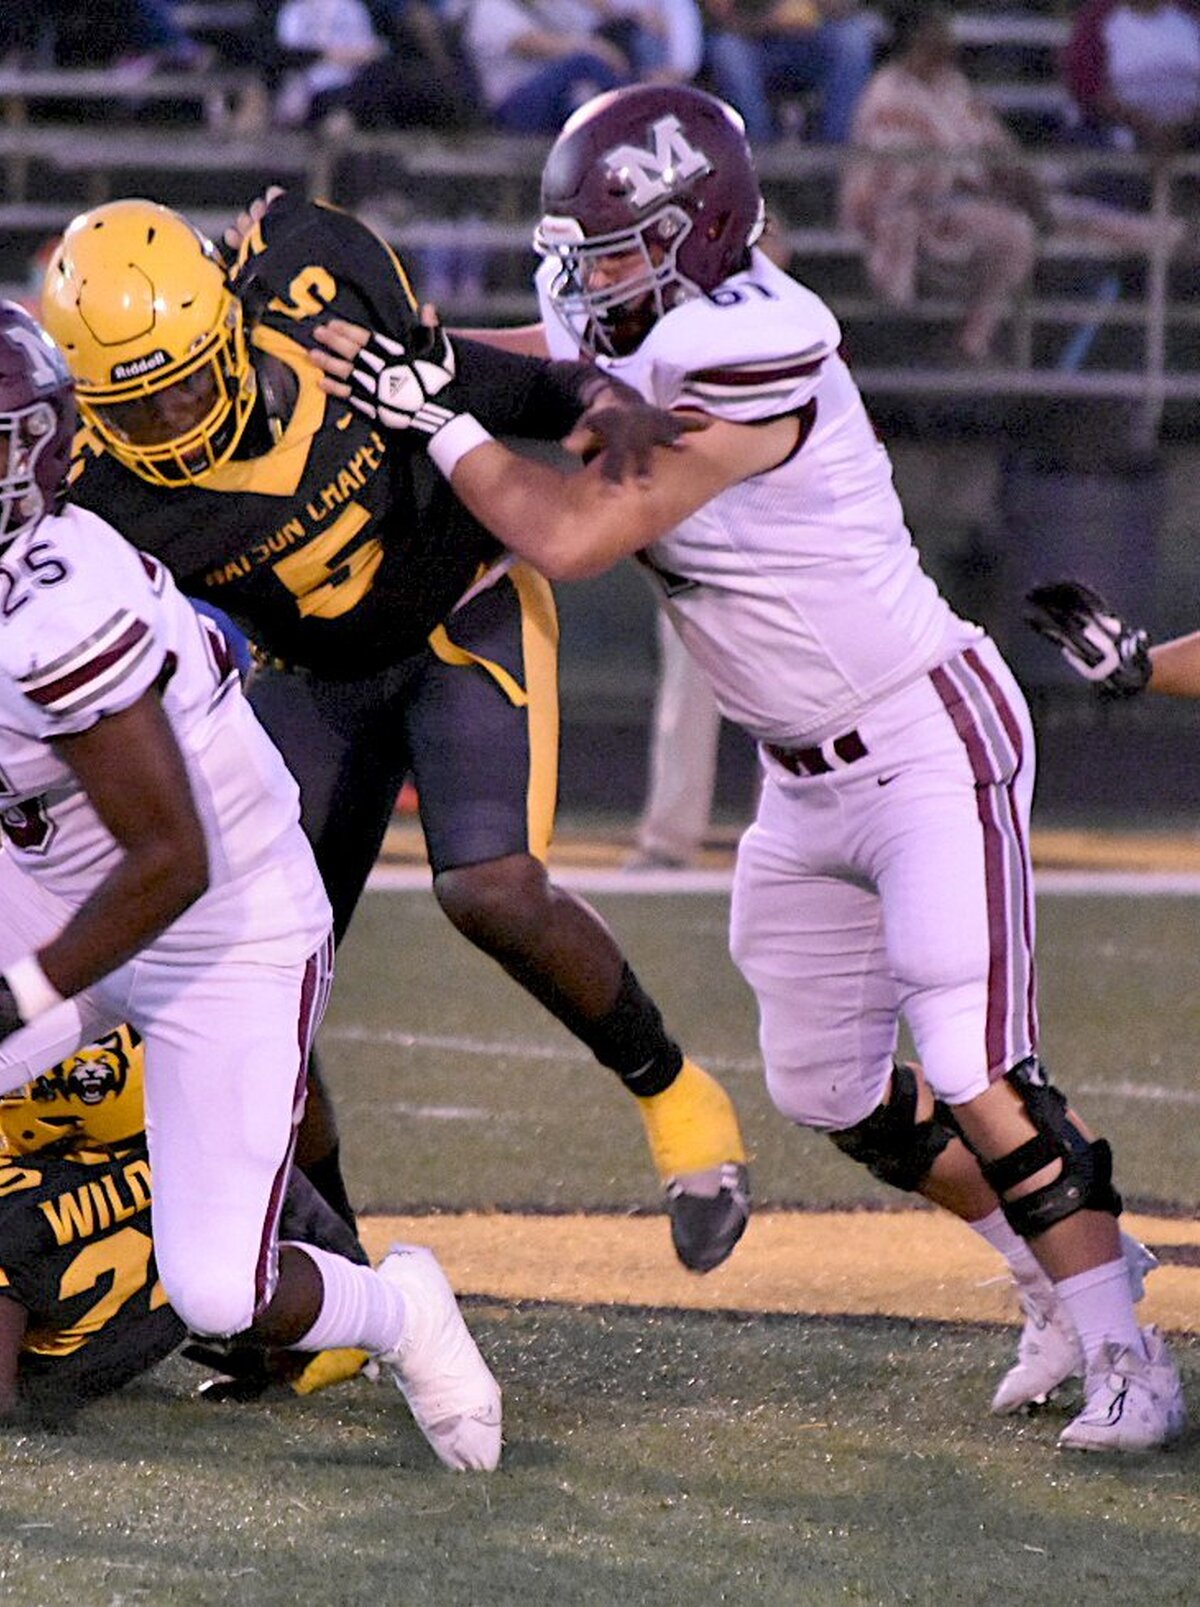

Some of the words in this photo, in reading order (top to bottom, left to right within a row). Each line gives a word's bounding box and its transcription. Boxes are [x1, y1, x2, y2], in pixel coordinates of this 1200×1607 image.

[602, 113, 713, 207] M
[115, 351, 167, 379] Riddell
[271, 500, 385, 619] 5
[29, 1226, 170, 1357] 2
